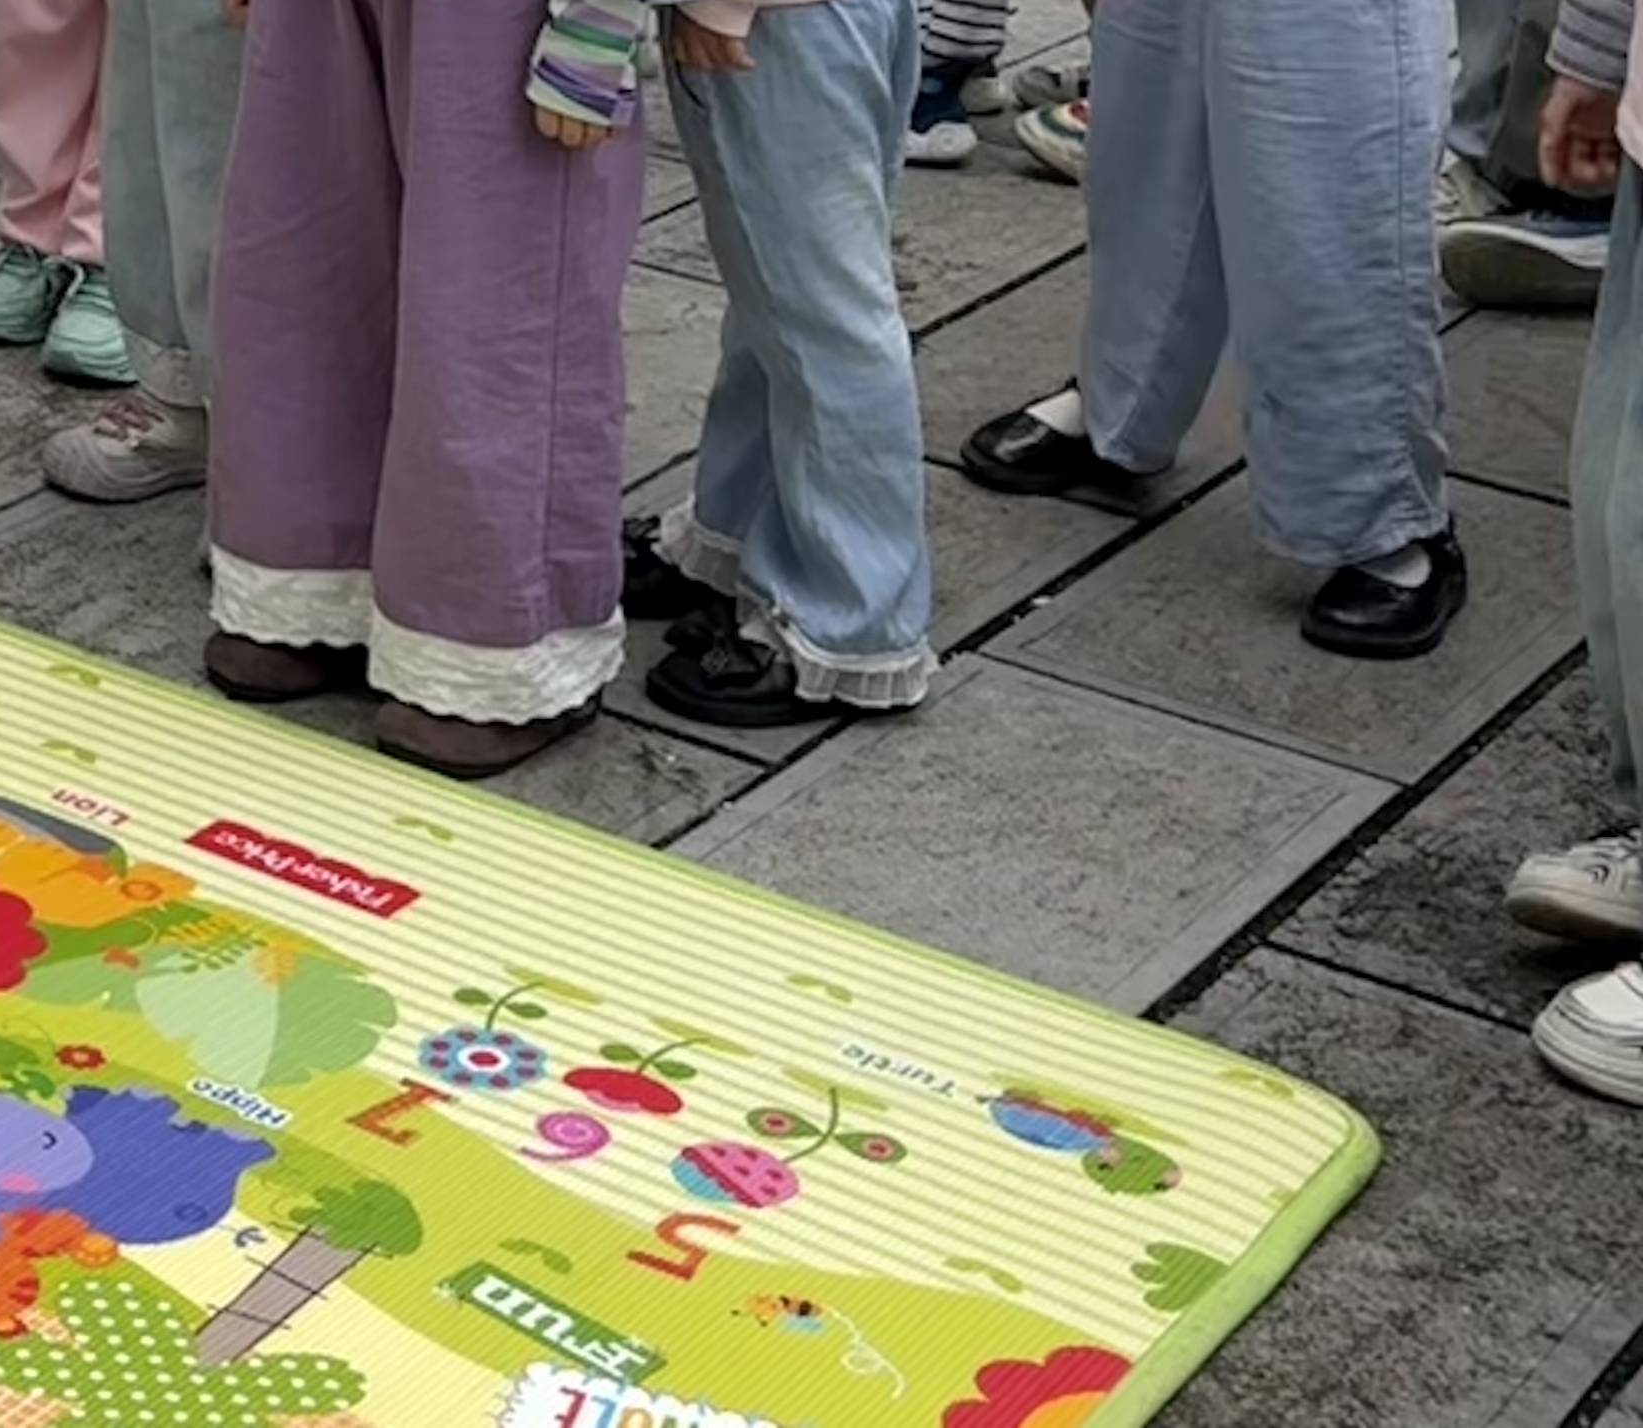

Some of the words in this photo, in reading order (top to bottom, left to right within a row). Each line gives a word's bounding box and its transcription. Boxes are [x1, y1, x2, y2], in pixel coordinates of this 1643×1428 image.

[51, 788, 131, 826] Lion
[842, 1044, 955, 1098] Turtle
[192, 1079, 287, 1125] Hippo
[470, 1273, 648, 1379] Fun
